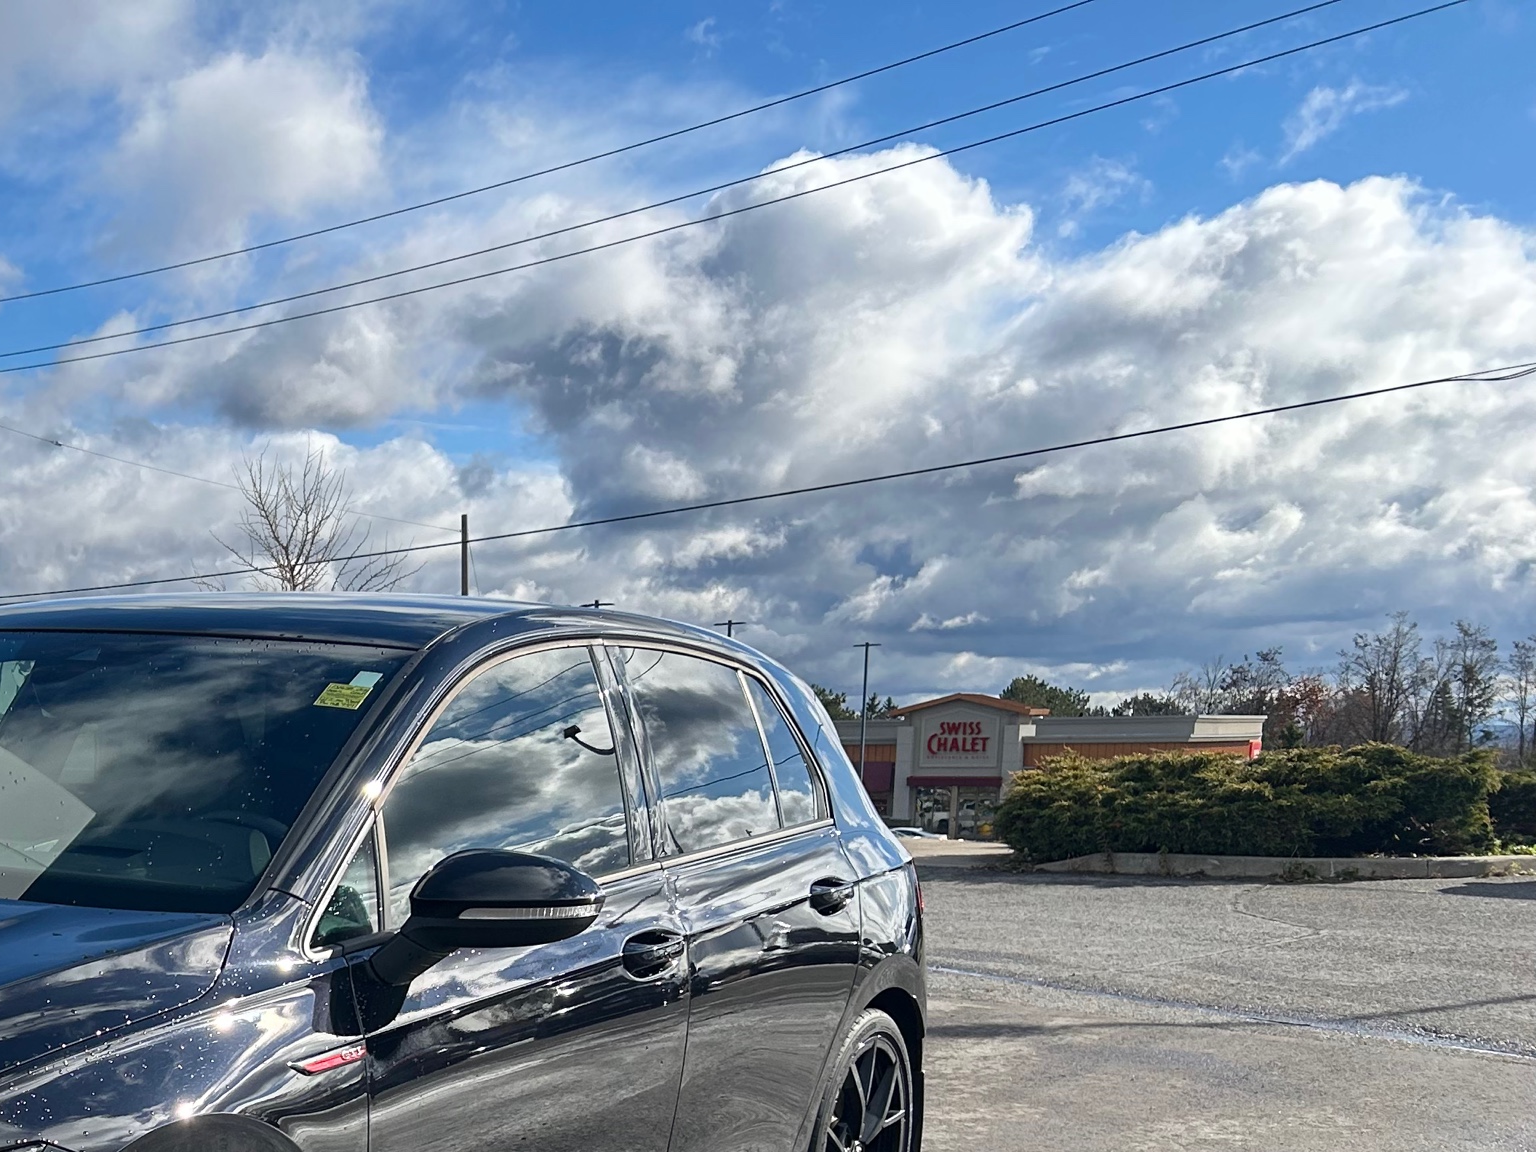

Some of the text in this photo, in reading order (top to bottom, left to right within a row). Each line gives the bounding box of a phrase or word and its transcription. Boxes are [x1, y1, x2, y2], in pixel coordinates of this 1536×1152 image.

[939, 721, 982, 736] SWISS
[927, 732, 990, 755] CHALET
[341, 1045, 362, 1060] GTI
